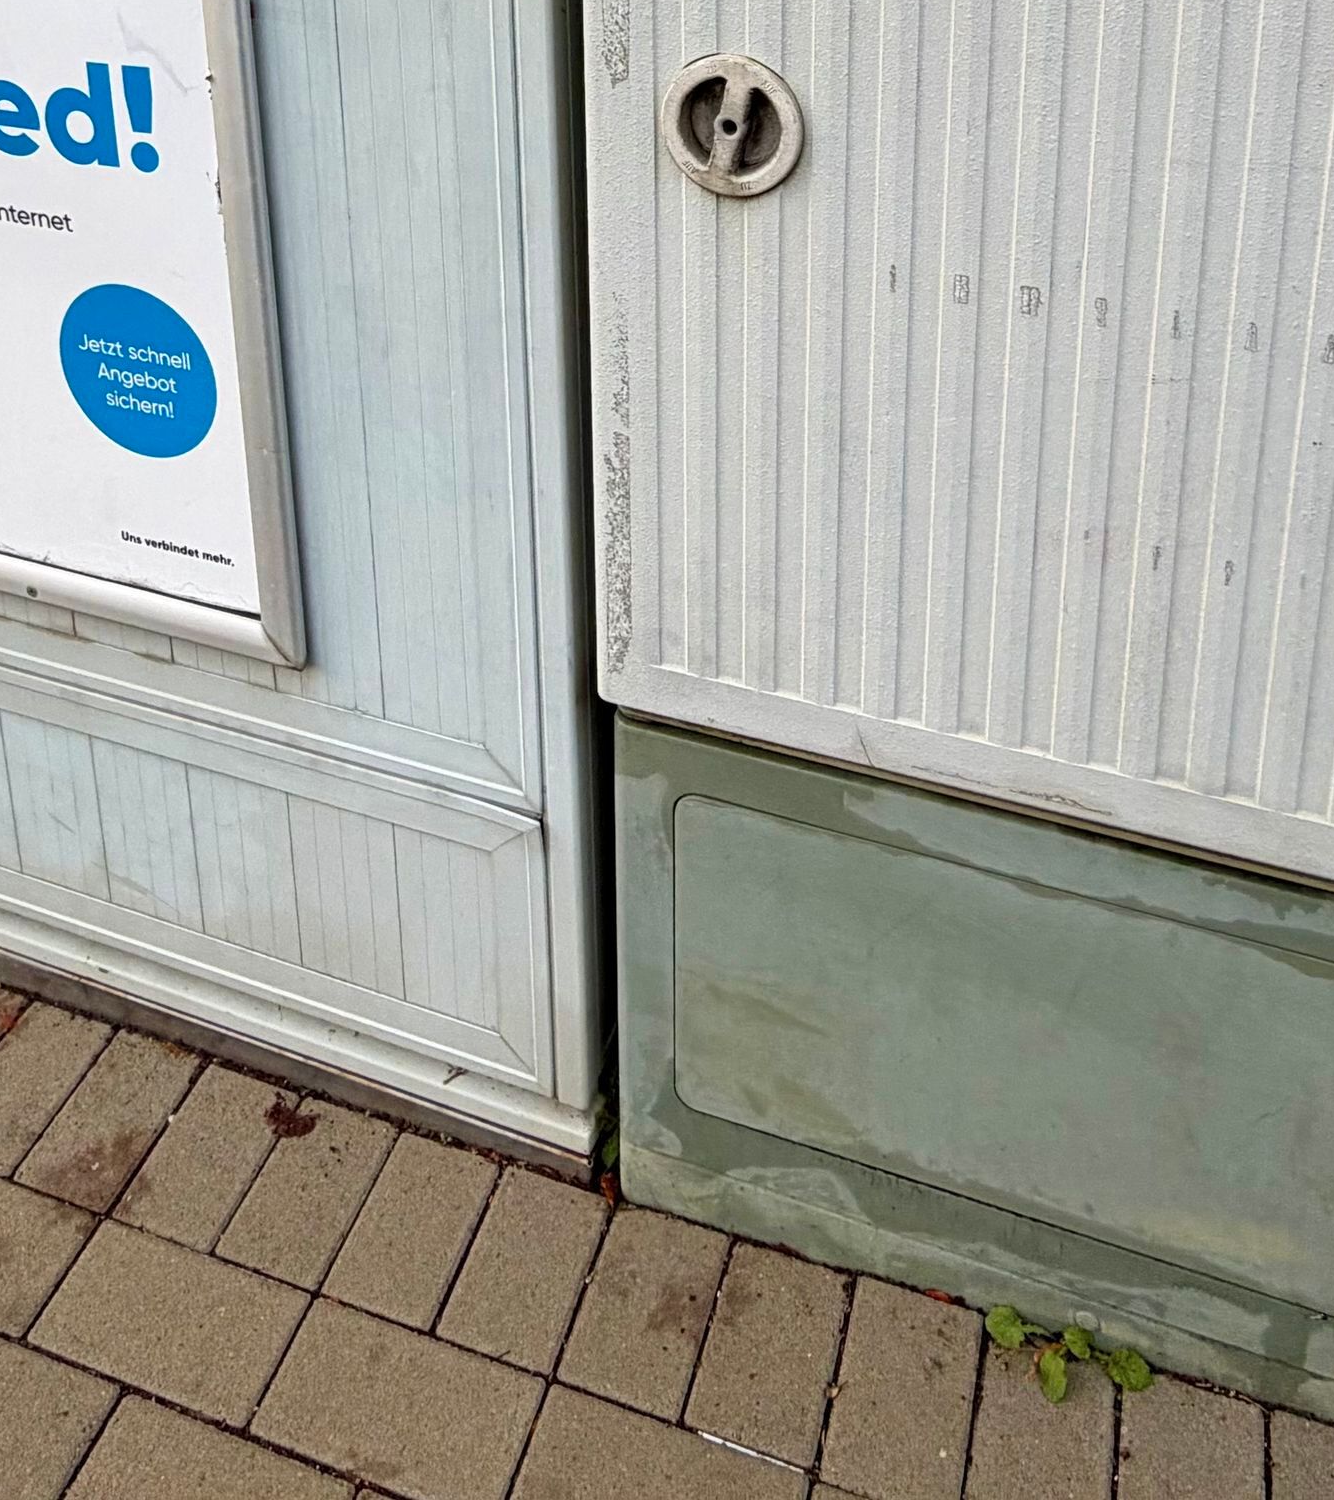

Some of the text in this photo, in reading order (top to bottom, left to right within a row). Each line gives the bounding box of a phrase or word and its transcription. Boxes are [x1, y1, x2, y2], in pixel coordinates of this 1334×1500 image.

[78, 333, 191, 371] Jetzt schnell
[98, 362, 178, 394] Angebot
[106, 390, 175, 419] sichern!
[121, 530, 235, 567] Uns verbindet mehr.
